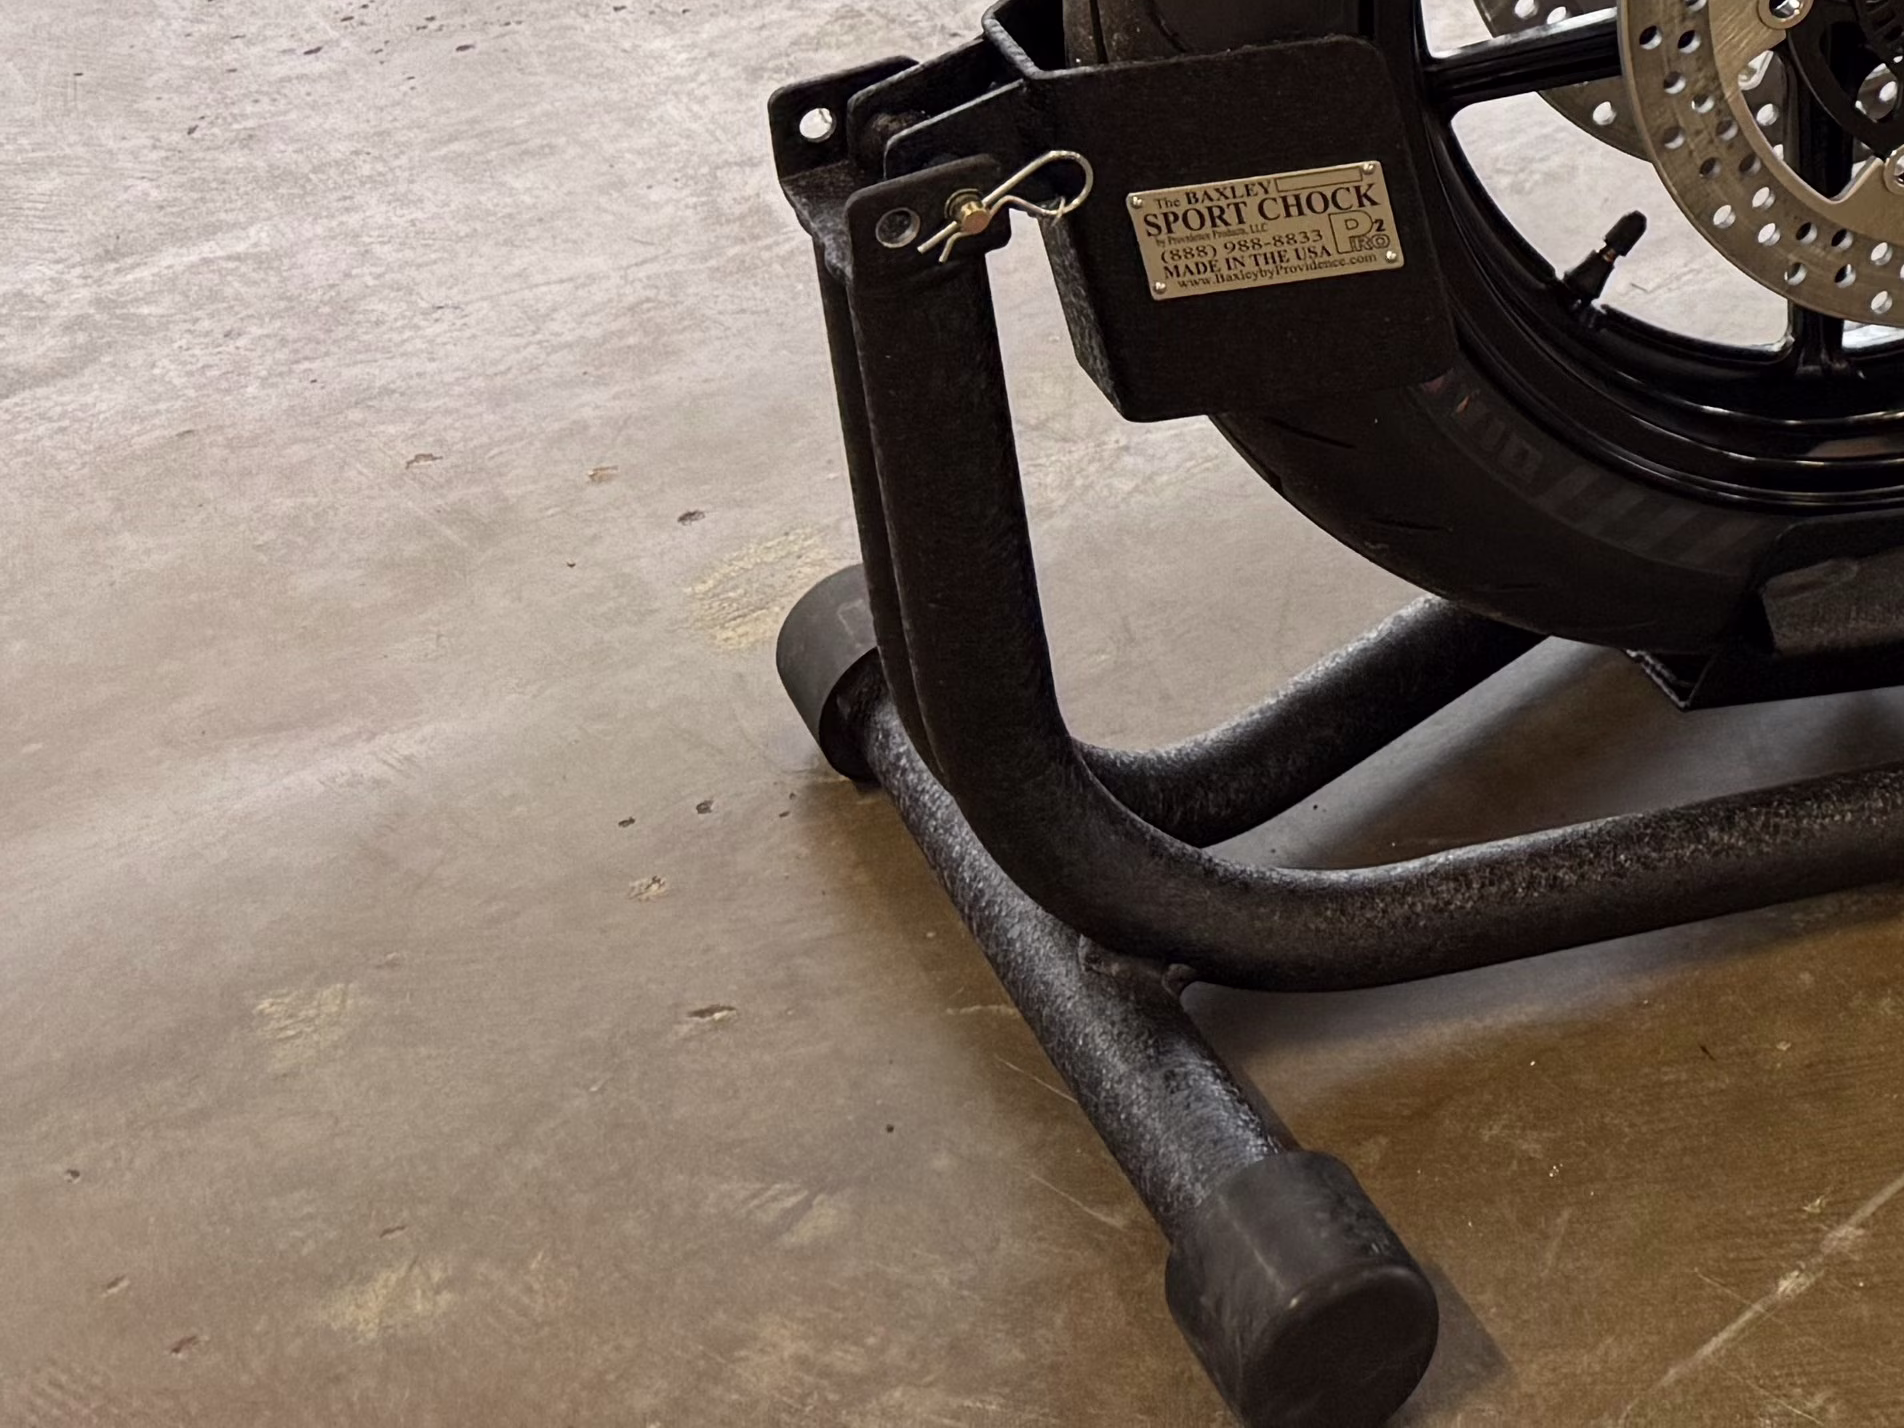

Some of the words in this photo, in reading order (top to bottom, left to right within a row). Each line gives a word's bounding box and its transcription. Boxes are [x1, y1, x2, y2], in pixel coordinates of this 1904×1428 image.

[1143, 200, 1248, 237] SPORT
[1257, 182, 1381, 221] CHOCK
[1153, 197, 1181, 209] The
[1184, 178, 1272, 205] BAXLEY
[1160, 244, 1218, 265] (888)
[1223, 229, 1324, 255] 988-8833
[1163, 259, 1222, 280] MADE
[1225, 256, 1246, 271] IN
[1249, 248, 1290, 268] THE
[1294, 245, 1332, 262] USA
